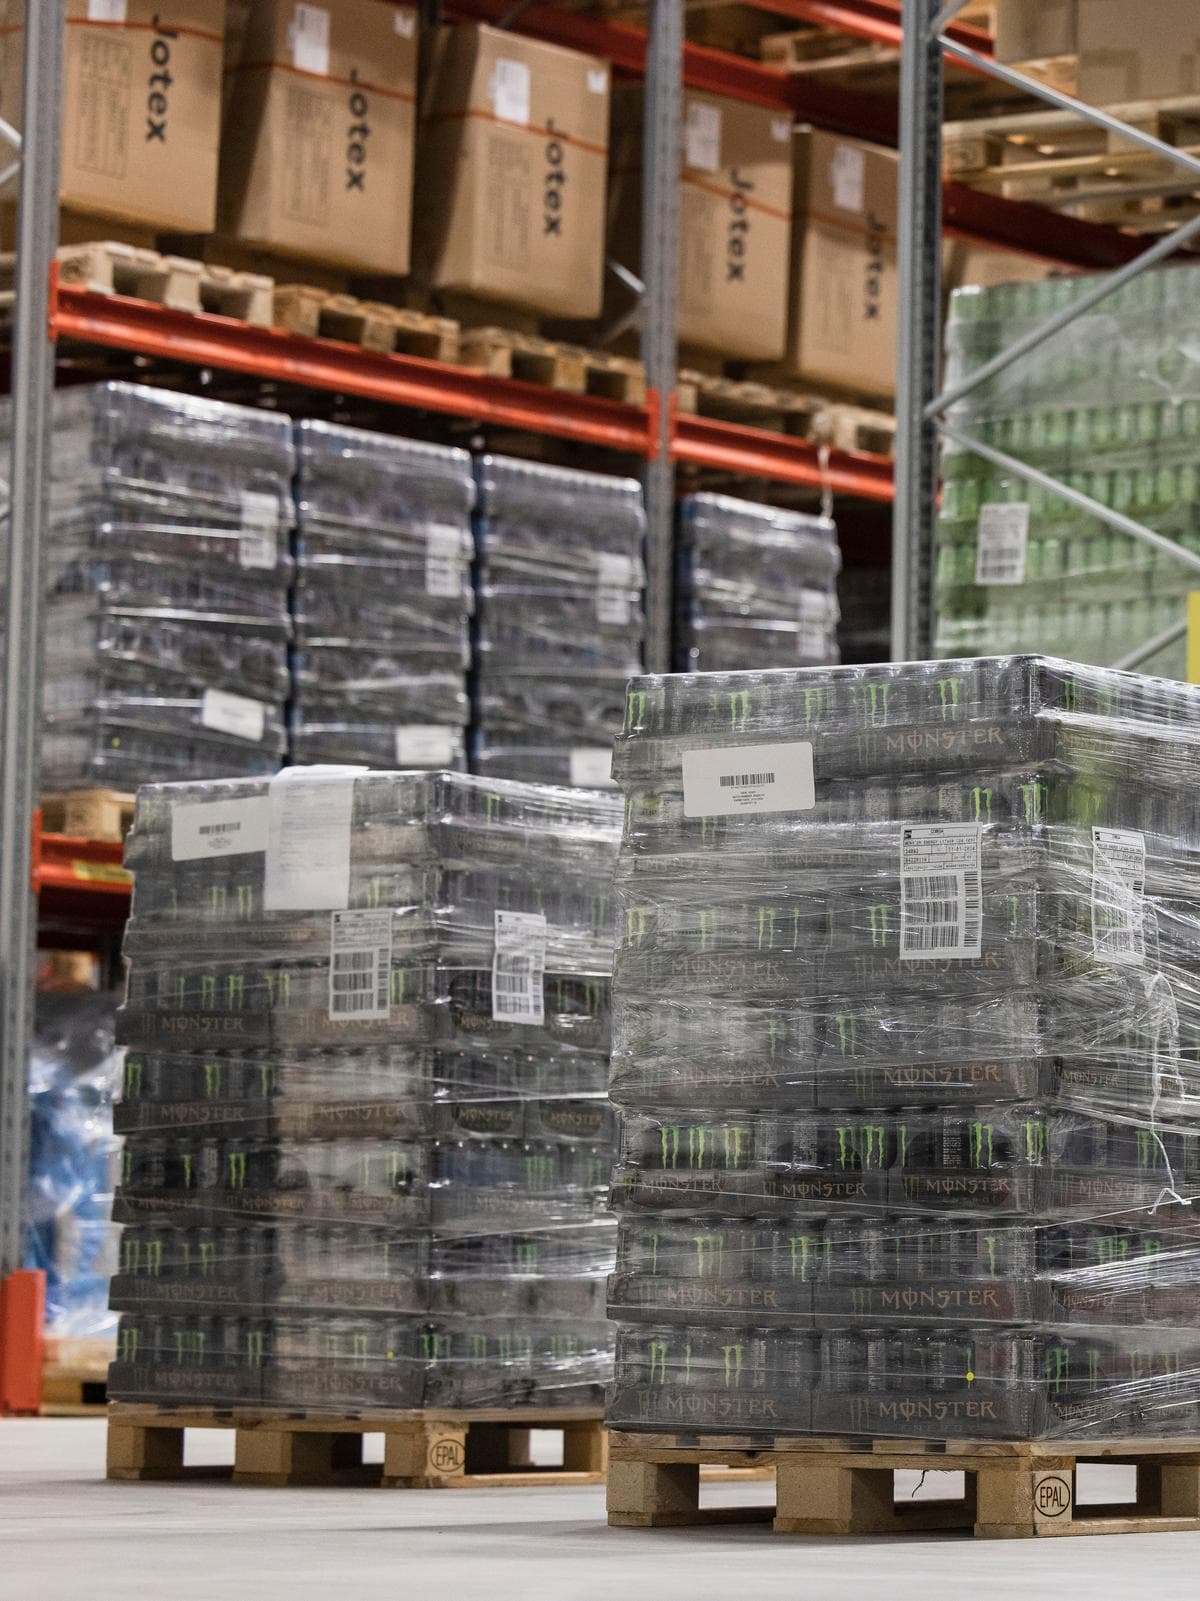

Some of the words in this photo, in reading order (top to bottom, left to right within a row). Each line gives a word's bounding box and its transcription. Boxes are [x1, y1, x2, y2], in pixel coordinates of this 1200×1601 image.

[146, 14, 178, 143] Jotex
[727, 168, 754, 282] Jotex
[886, 728, 1005, 753] MONSTER
[161, 1016, 246, 1032] MONSTER
[883, 1063, 1001, 1087] MONSTER
[782, 1179, 867, 1199] MONSTER
[926, 1174, 1011, 1195] MONSTER
[880, 1287, 1000, 1310] MONSTER
[879, 1396, 998, 1421] MONSTER
[436, 1445, 459, 1467] EPAL
[1040, 1486, 1066, 1508] EPAL
